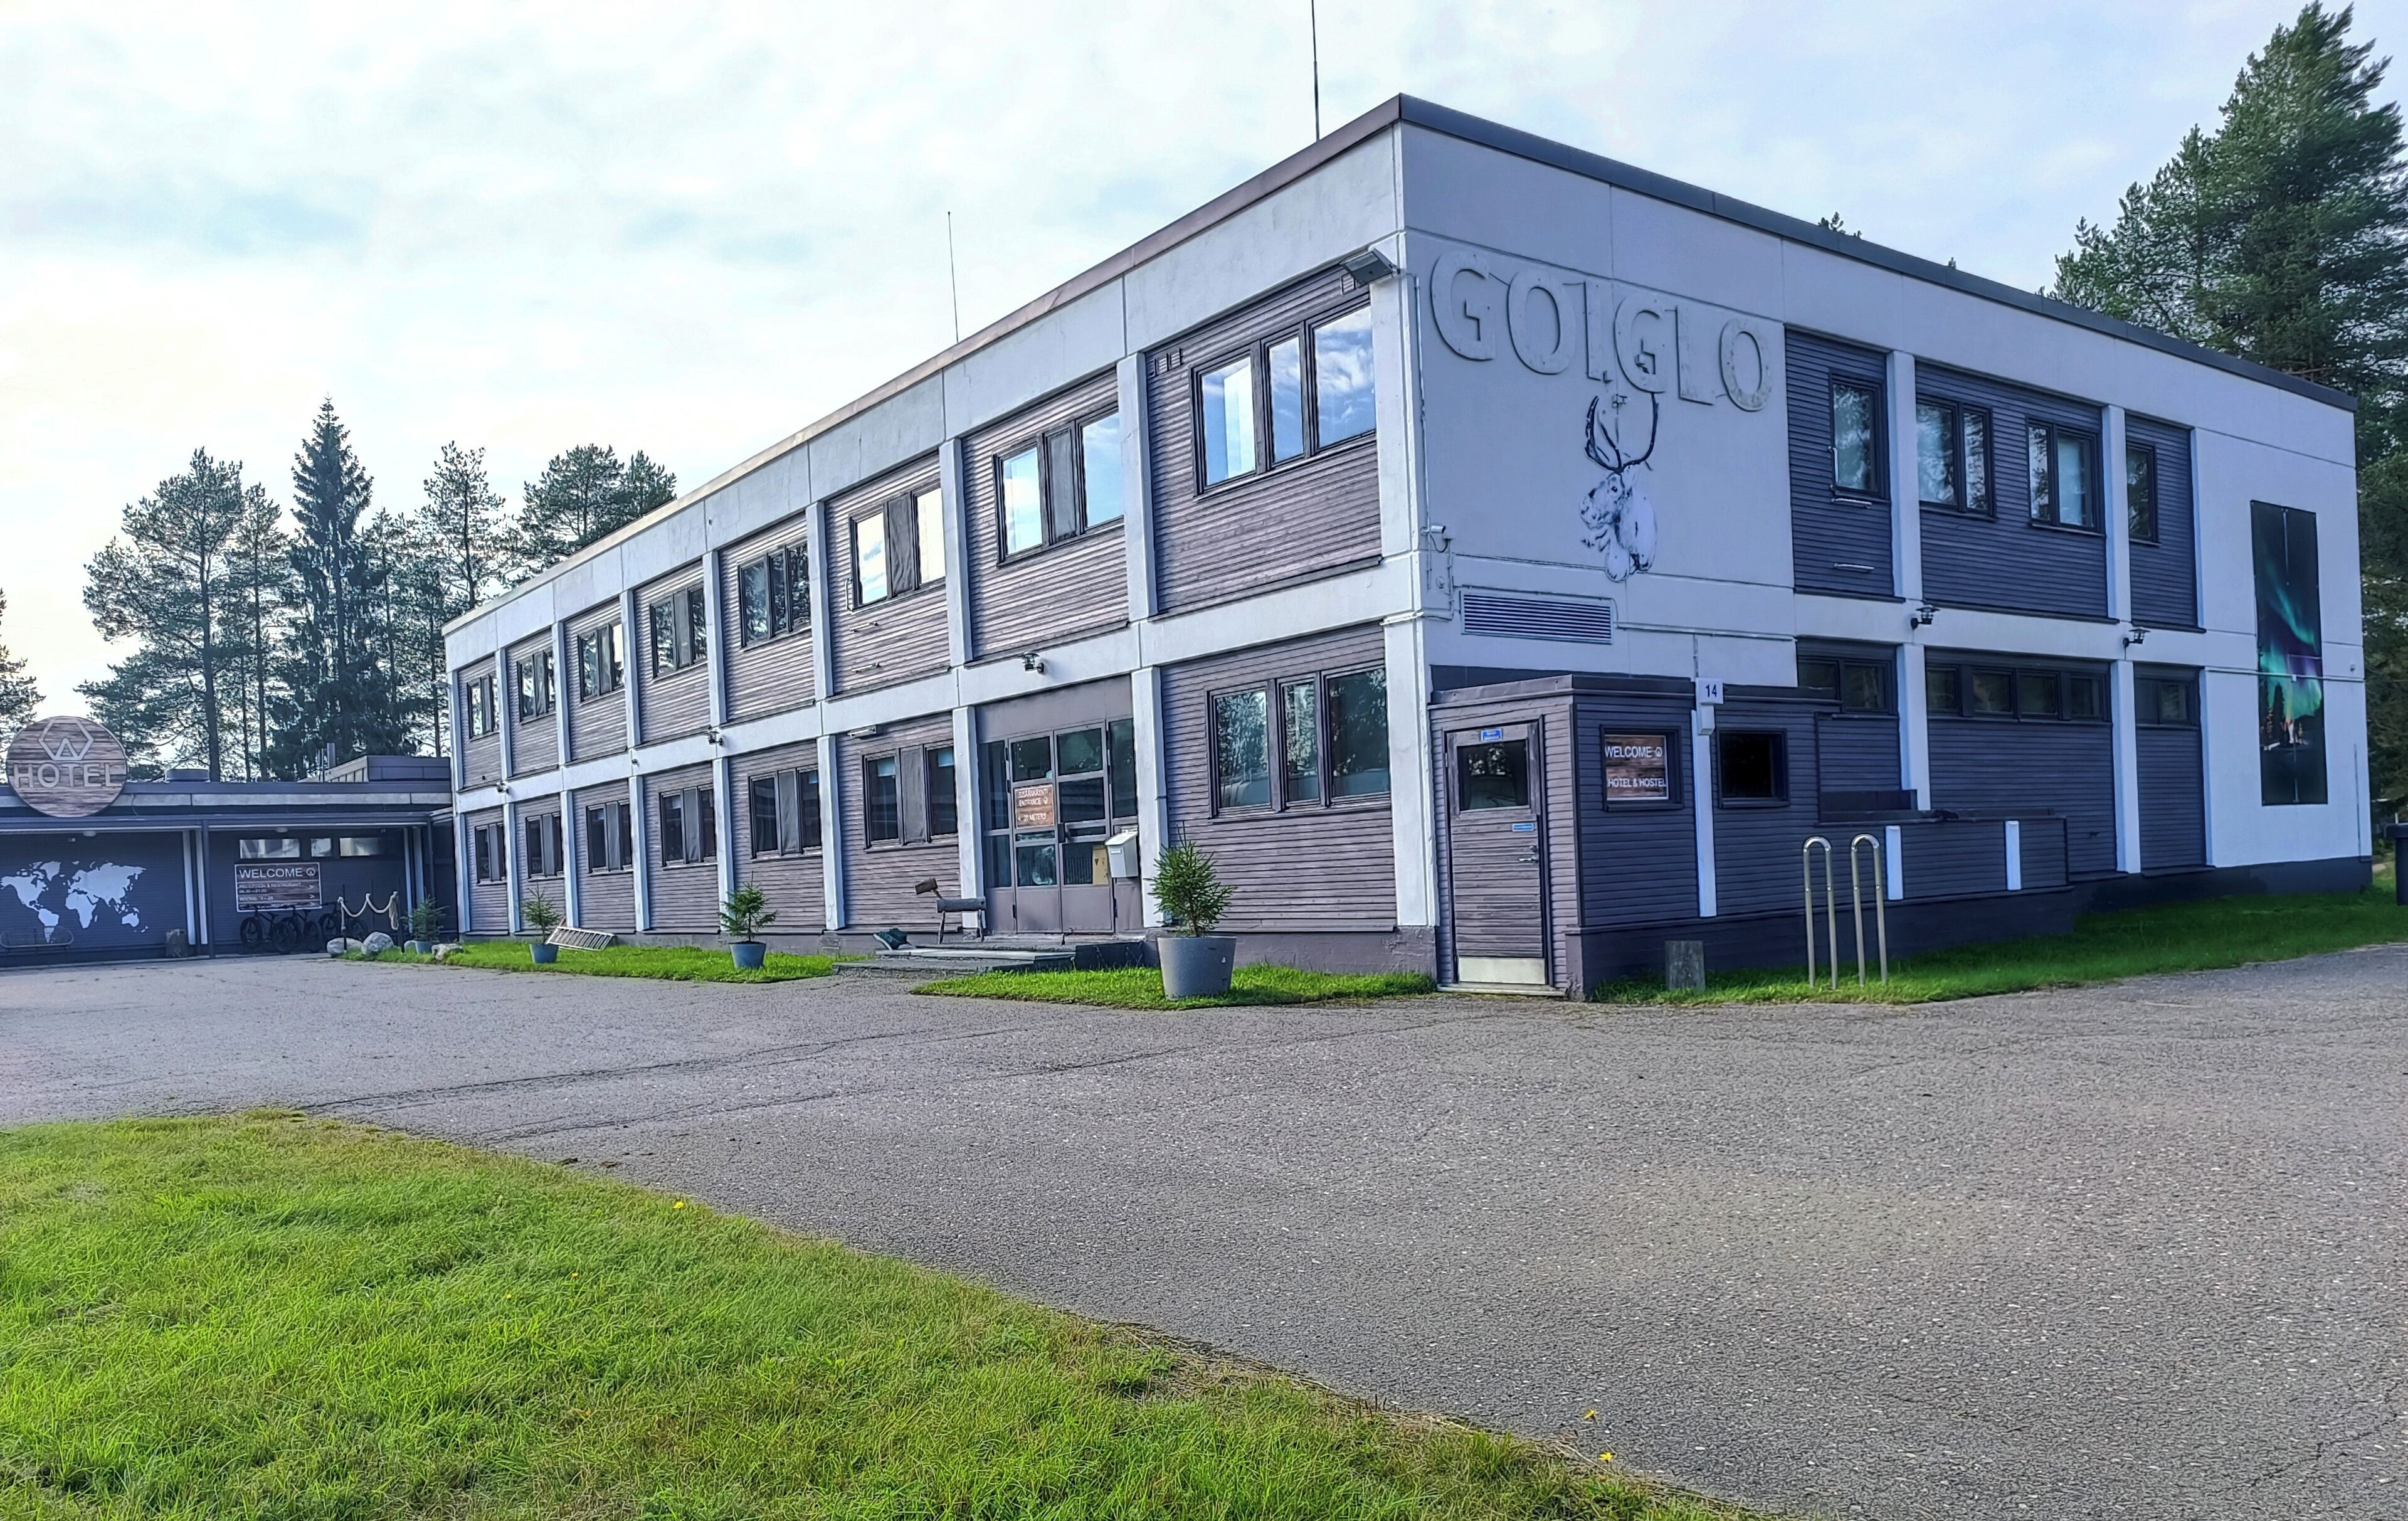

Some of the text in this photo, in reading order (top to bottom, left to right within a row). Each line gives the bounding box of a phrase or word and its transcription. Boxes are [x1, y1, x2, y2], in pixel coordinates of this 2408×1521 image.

[1706, 684, 1717, 697] 14
[1605, 745, 1652, 758] WELCOME
[14, 763, 123, 788] HOTEL
[1608, 778, 1666, 788] HOTEL & HOSTEL
[239, 867, 304, 878] WELCOME
